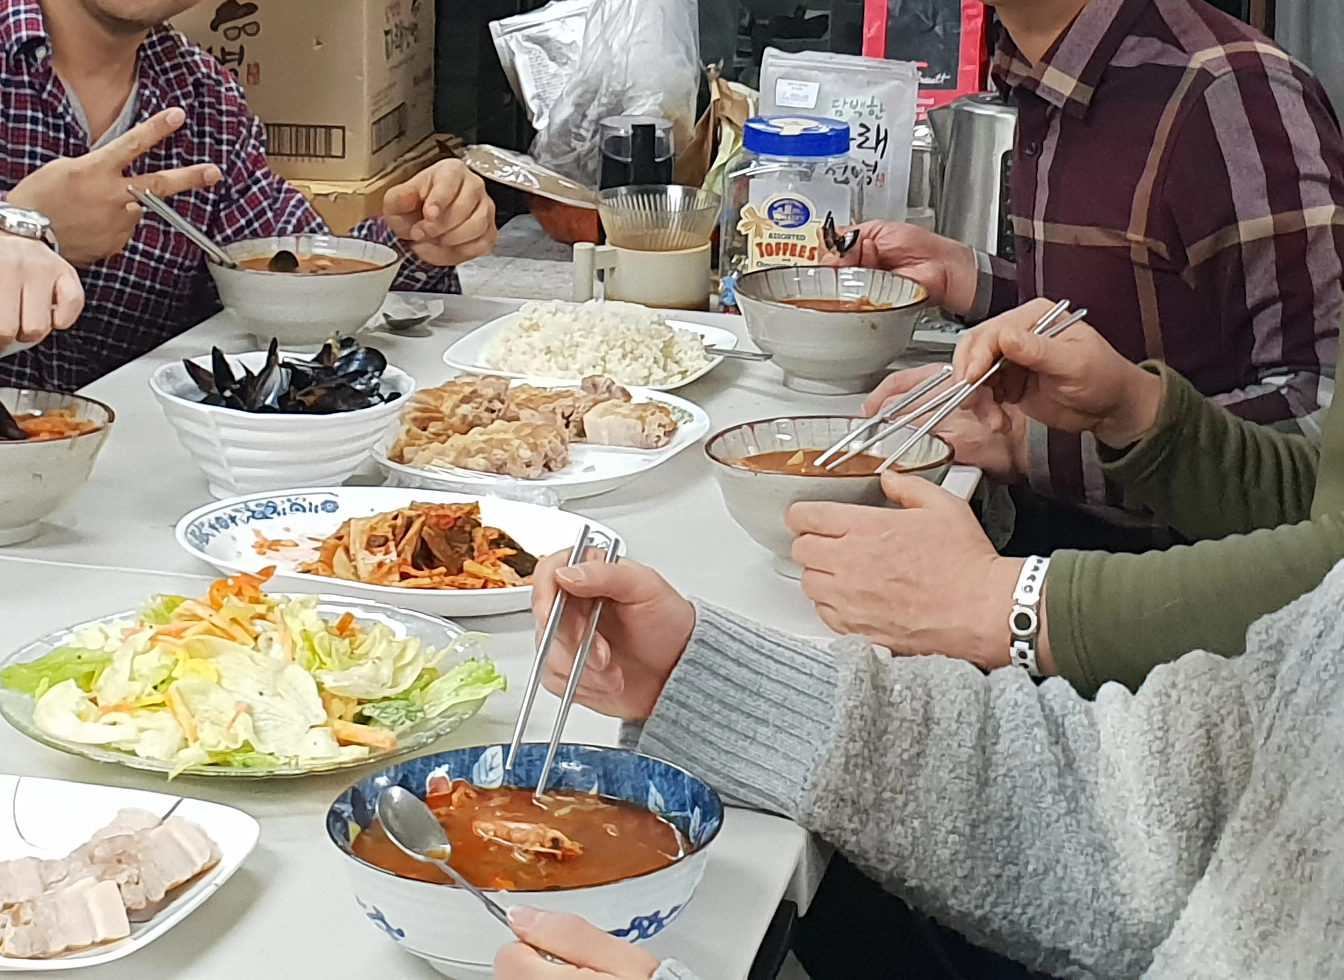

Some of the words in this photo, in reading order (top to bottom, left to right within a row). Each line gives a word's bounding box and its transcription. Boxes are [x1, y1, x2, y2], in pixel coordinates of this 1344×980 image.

[831, 95, 886, 121] 담백한
[849, 122, 888, 160] 래
[768, 232, 806, 241] ASSORTED
[755, 241, 817, 261] TOFFEES
